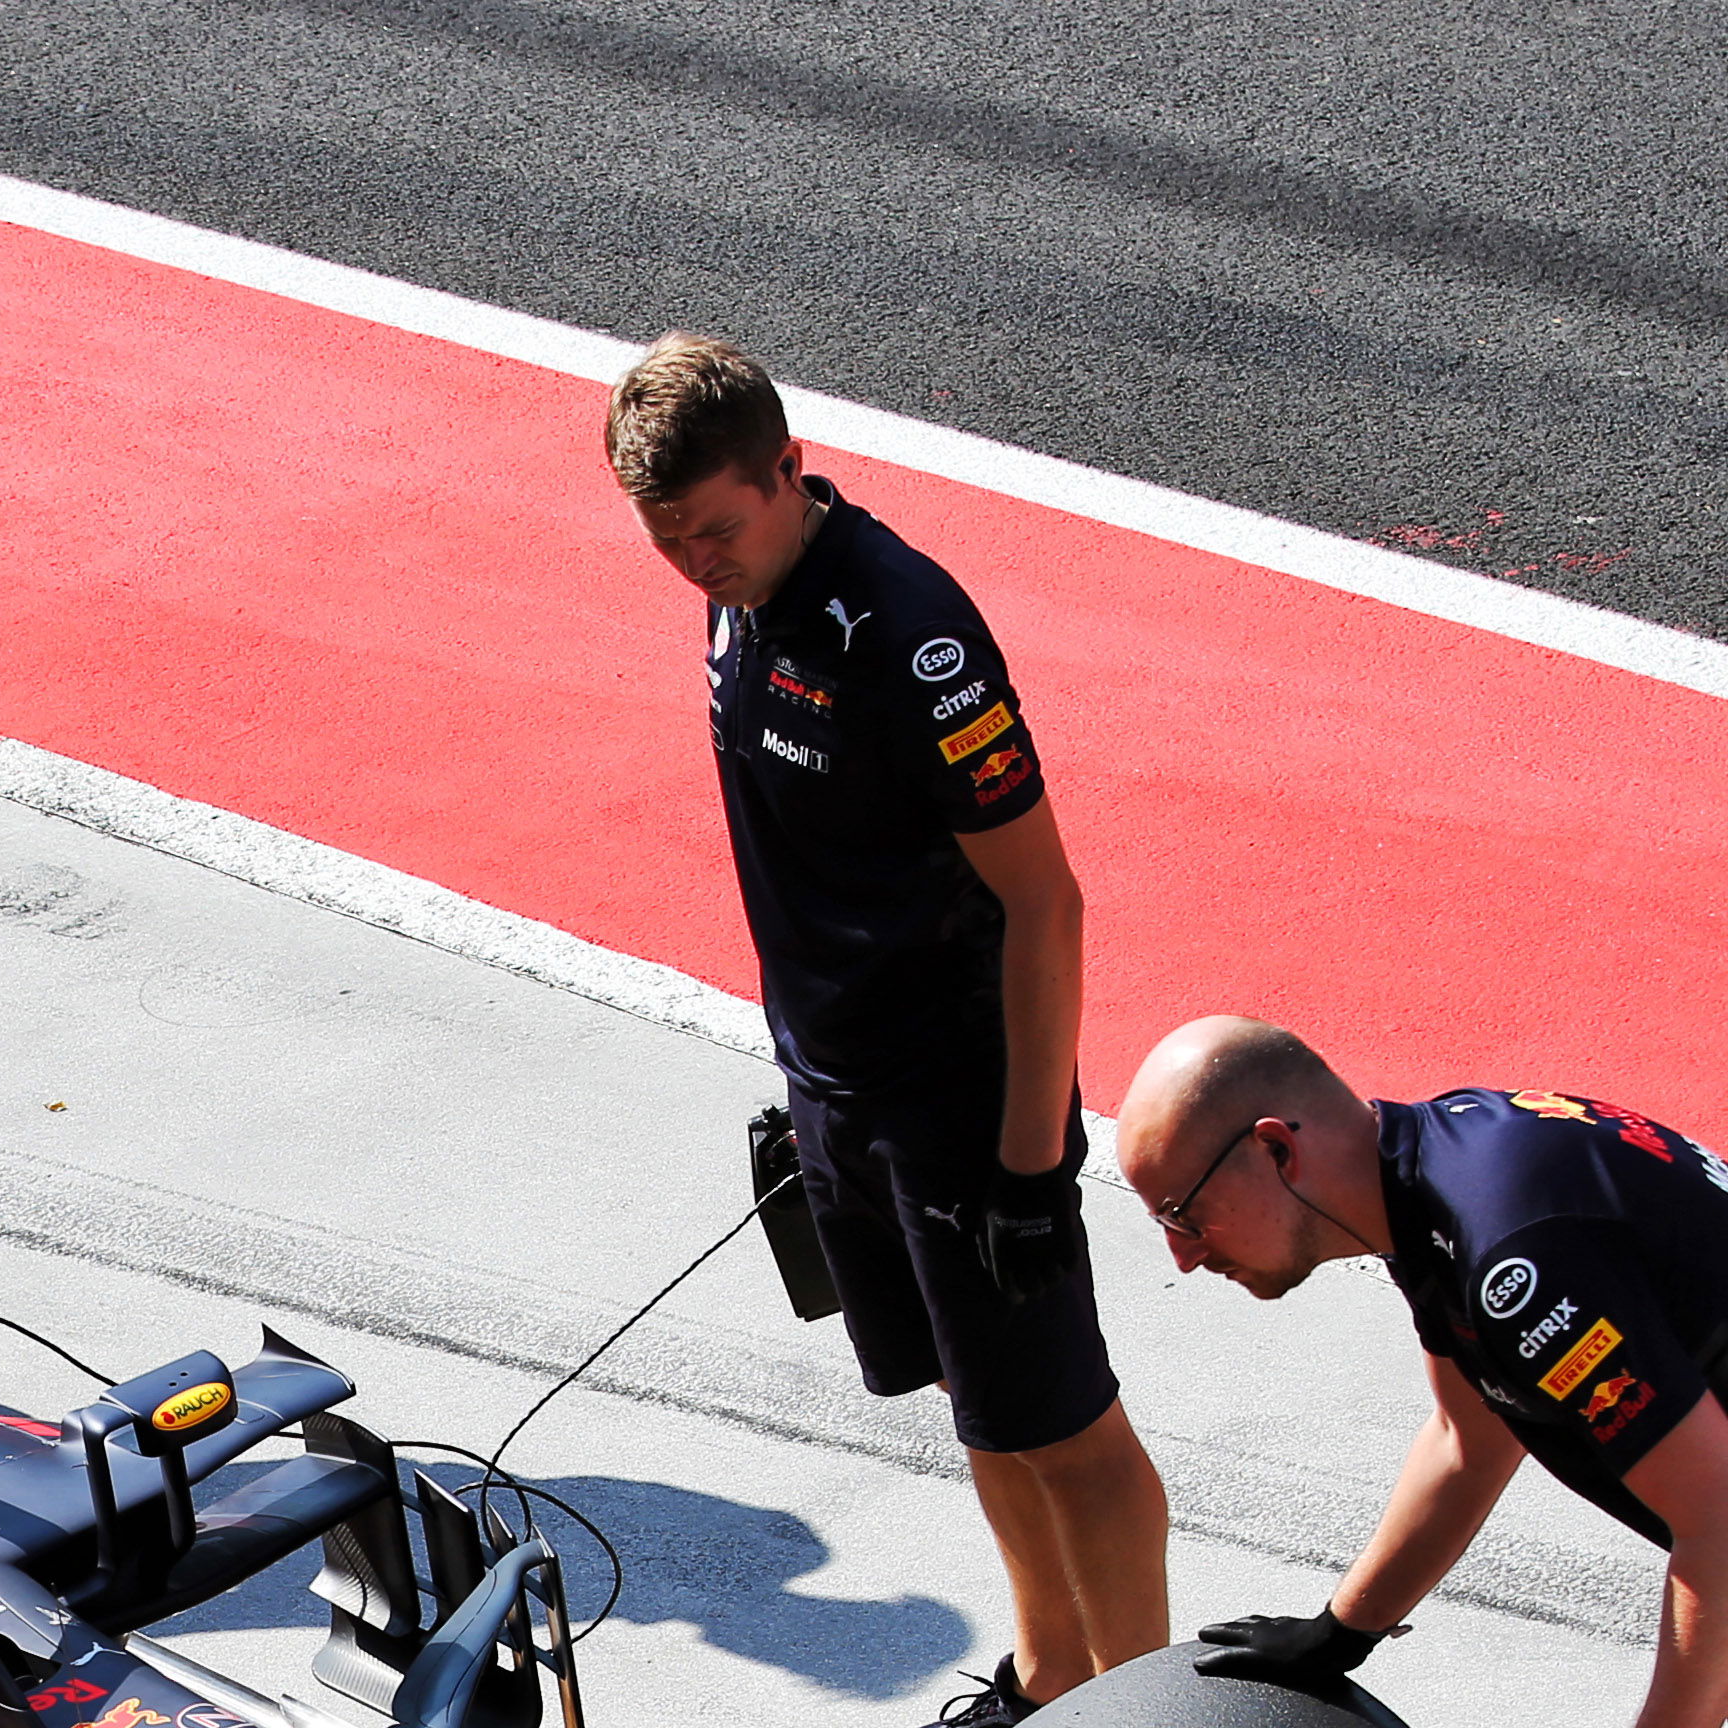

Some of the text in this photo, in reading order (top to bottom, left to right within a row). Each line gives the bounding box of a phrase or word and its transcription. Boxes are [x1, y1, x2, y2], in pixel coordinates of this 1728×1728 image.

[920, 646, 957, 672] Esso
[761, 728, 809, 767] Mobil
[946, 708, 1007, 757] PIRELLI
[1486, 1266, 1529, 1310] Esso
[1547, 1327, 1613, 1393] PIRELLI
[173, 1387, 223, 1420] RAUCH
